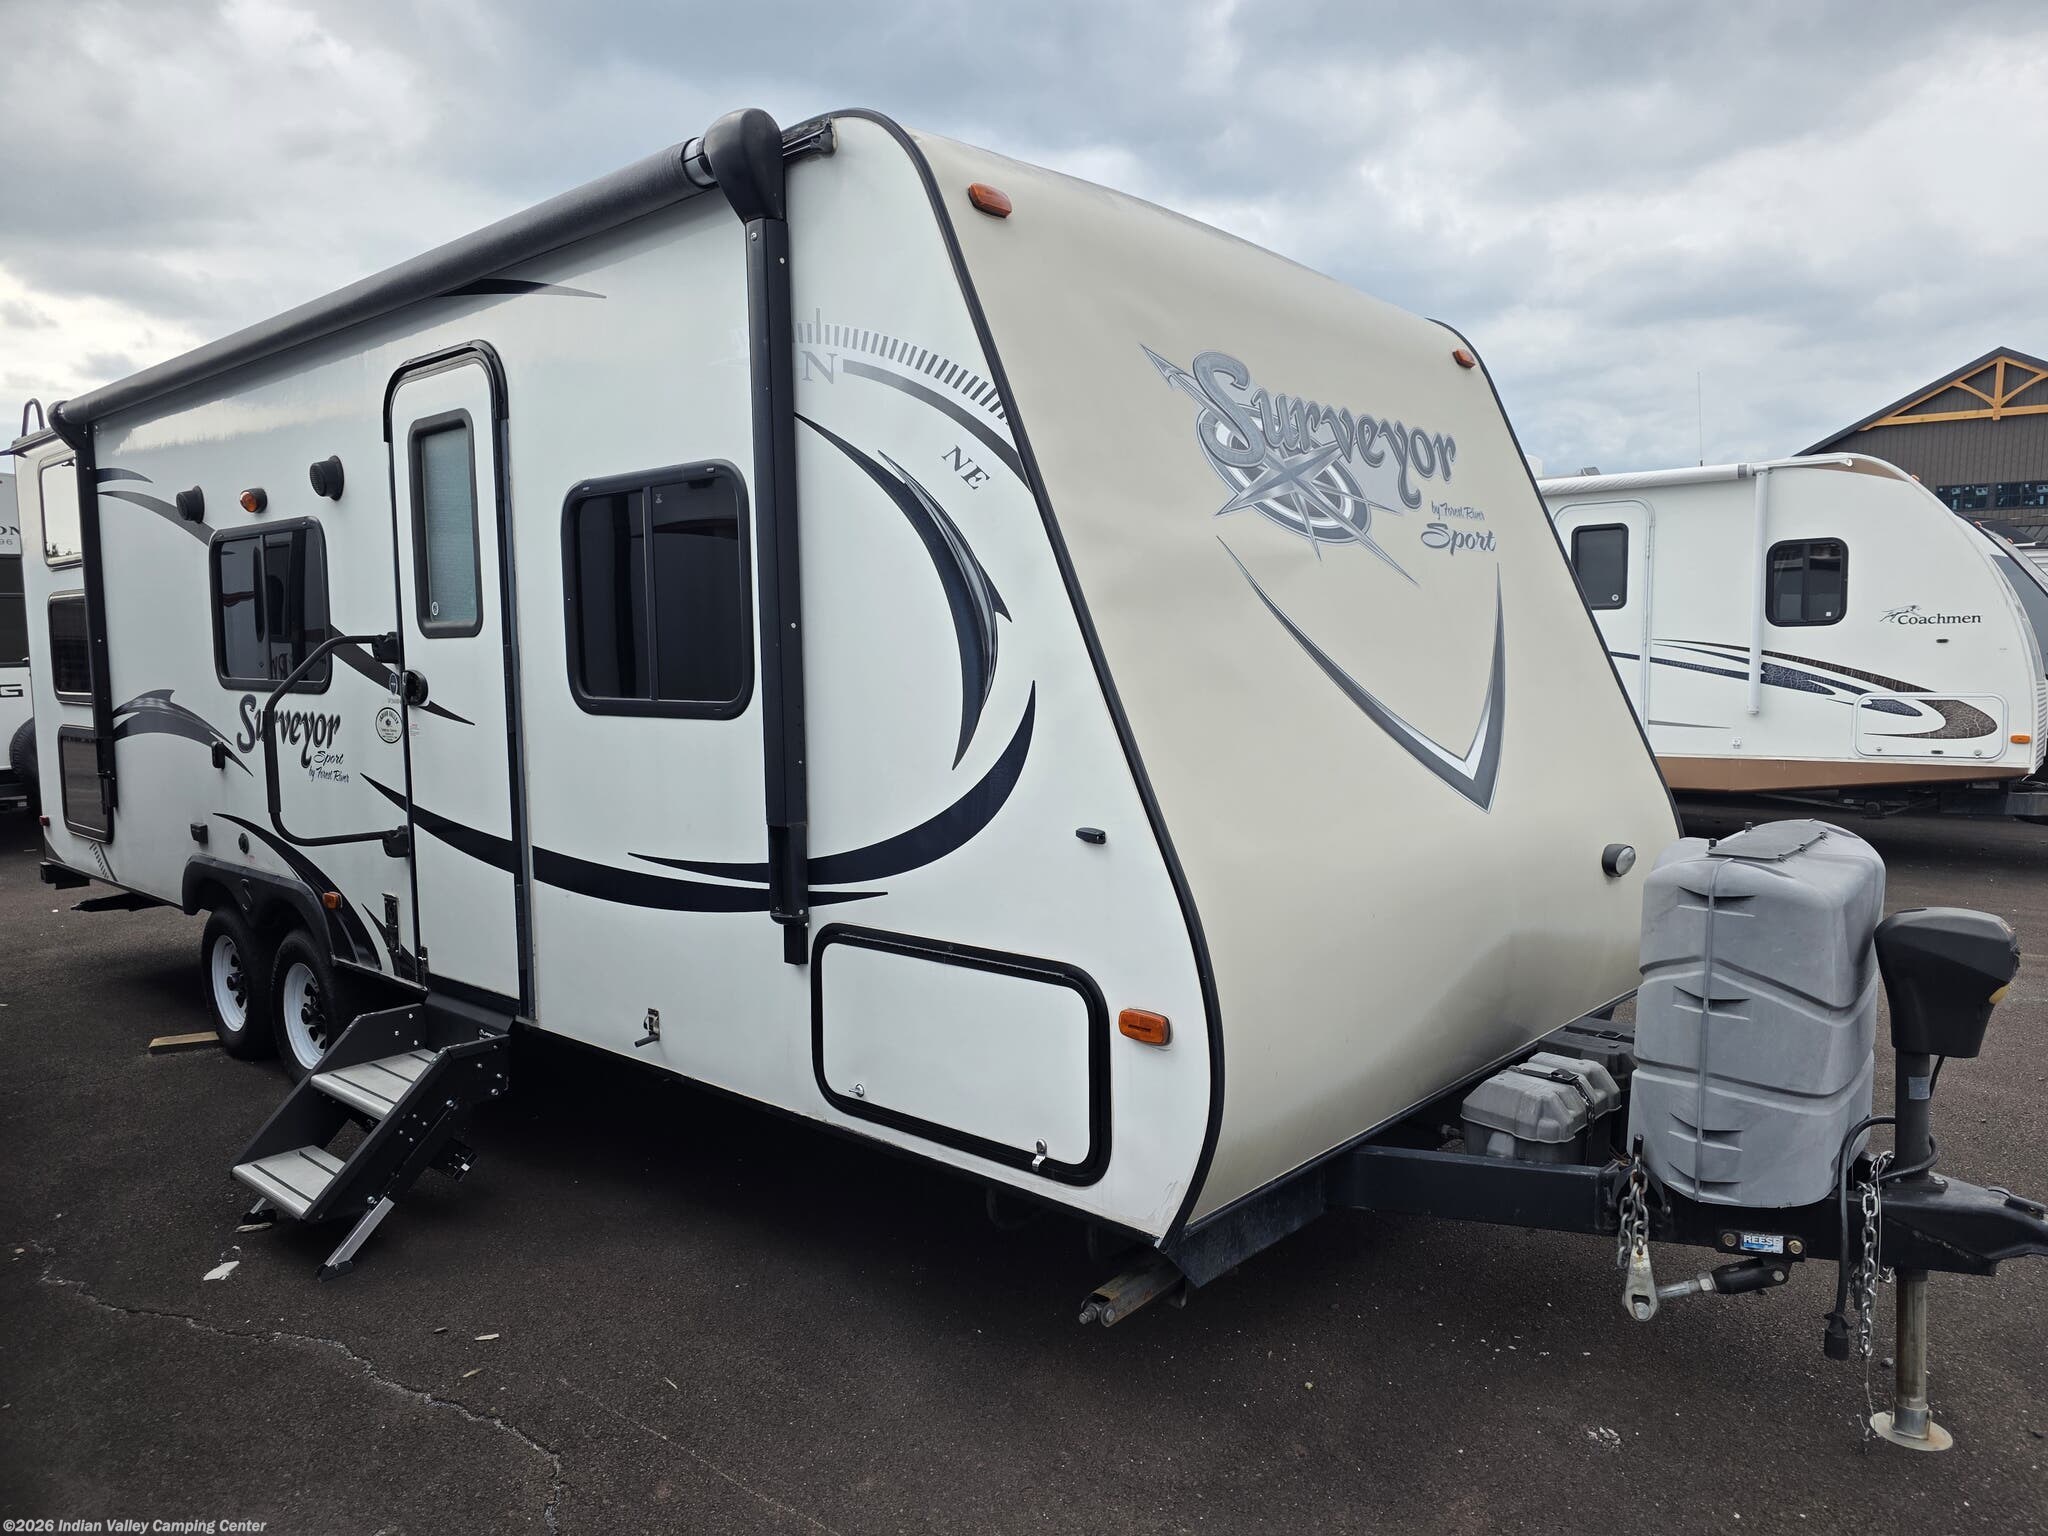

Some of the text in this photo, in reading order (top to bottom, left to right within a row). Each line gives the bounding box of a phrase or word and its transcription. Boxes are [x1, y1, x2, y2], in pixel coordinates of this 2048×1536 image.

[800, 351, 838, 384] N
[1193, 351, 1456, 508] Surveyor
[941, 444, 990, 490] NE
[1421, 522, 1496, 556] Sport
[1898, 613, 1982, 625] Coachmen
[313, 750, 344, 766] Sport
[1744, 1235, 1781, 1247] REESE
